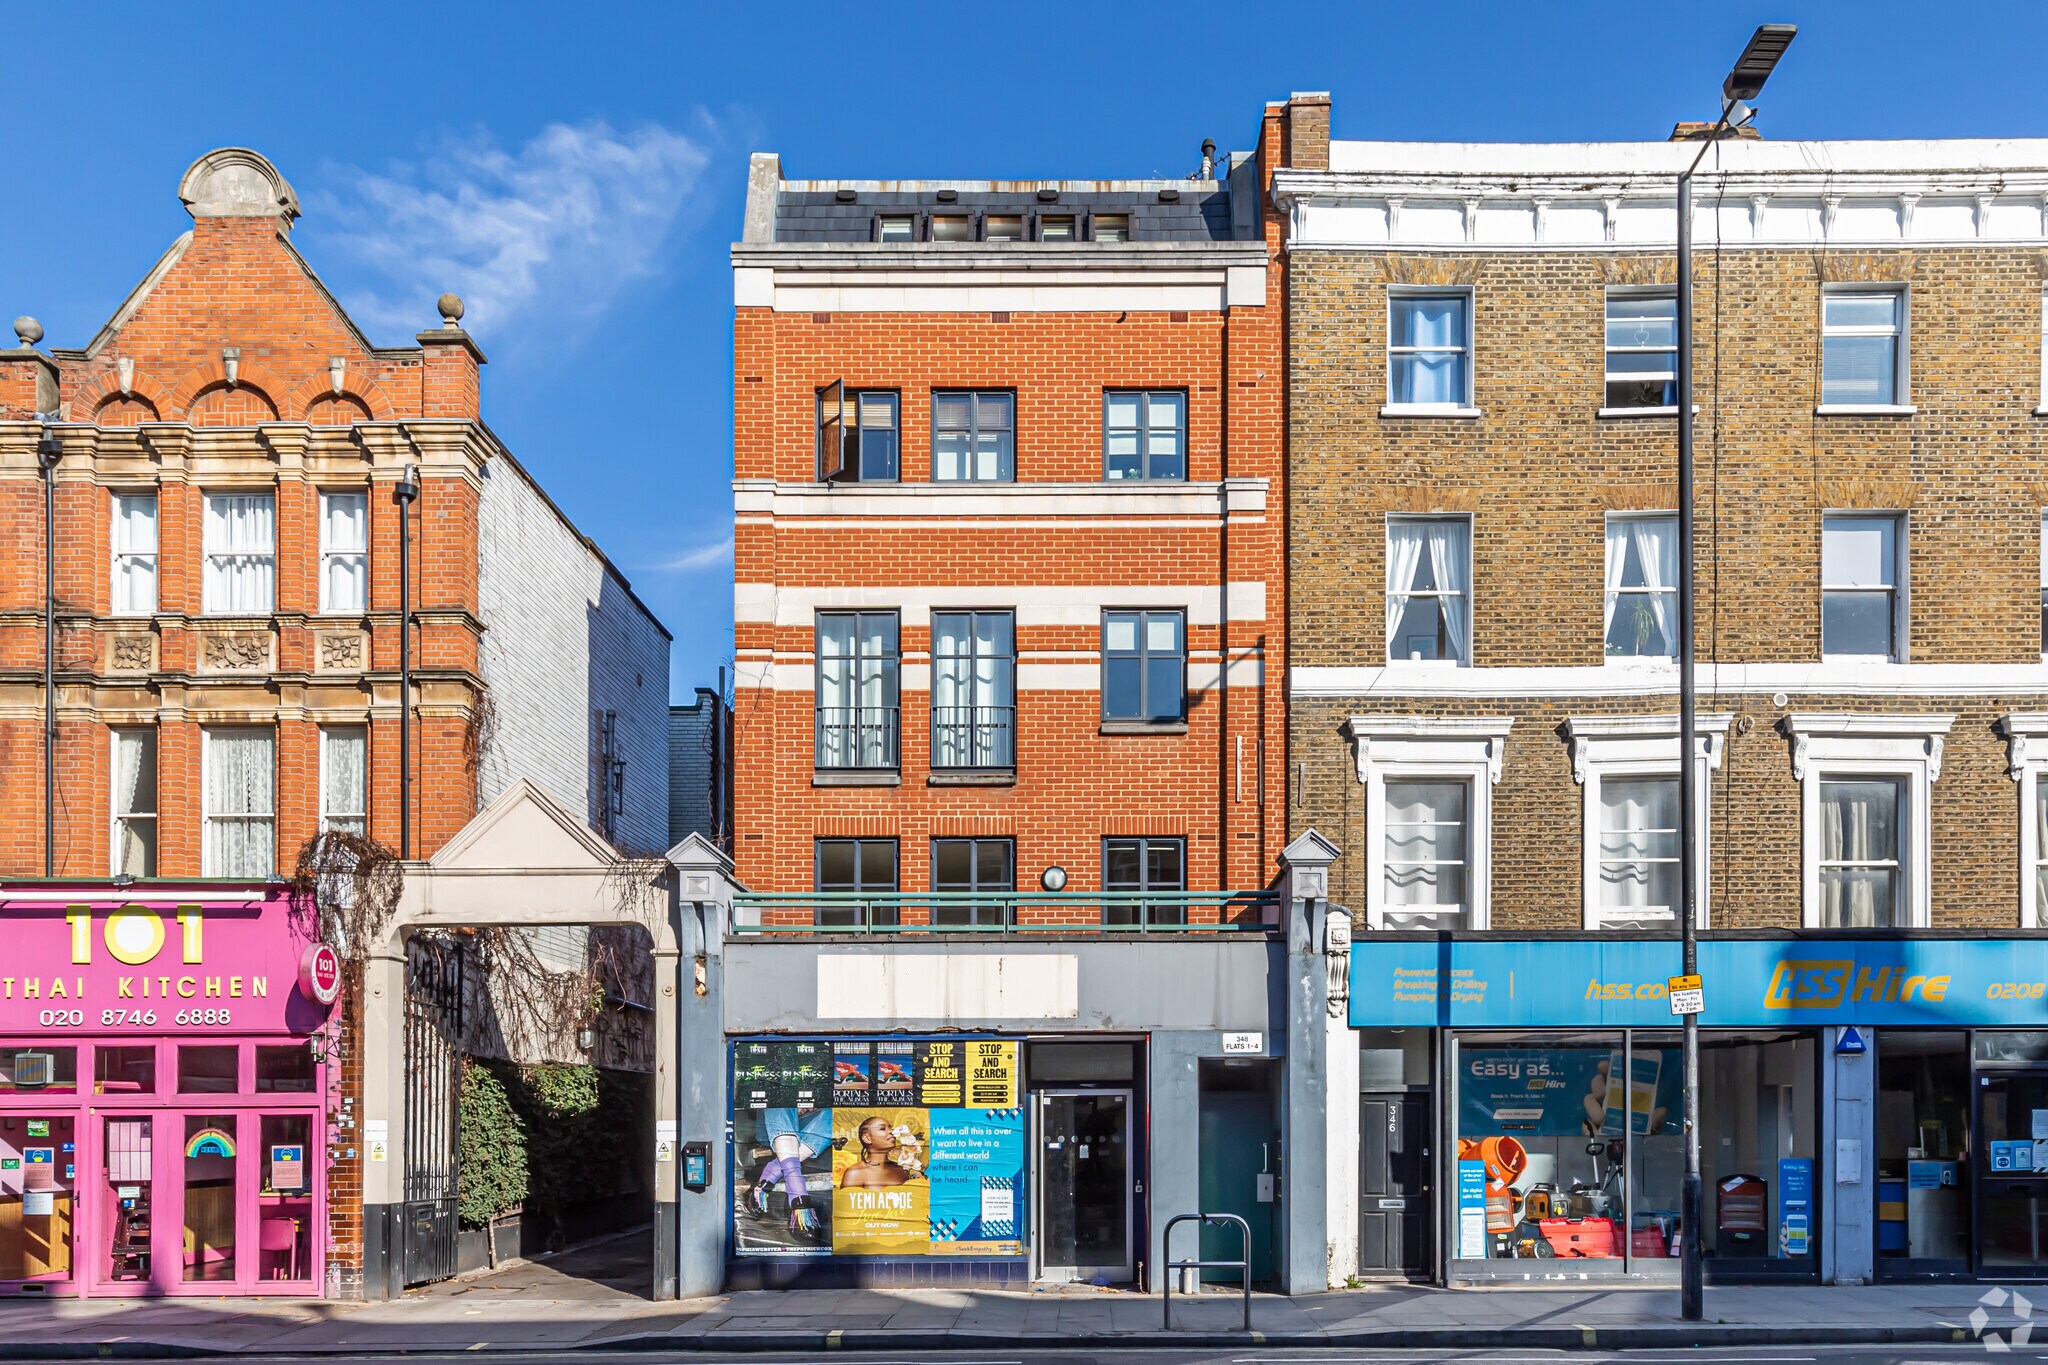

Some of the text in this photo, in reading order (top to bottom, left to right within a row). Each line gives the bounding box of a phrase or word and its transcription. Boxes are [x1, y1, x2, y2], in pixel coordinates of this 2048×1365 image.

[66, 904, 203, 965] 101
[318, 958, 333, 972] 101
[1393, 967, 1438, 977] Powered
[3, 976, 267, 999] THAI KITCHEN
[1393, 979, 1438, 991] Breaking
[1452, 979, 1488, 991] Drilling
[1774, 966, 1951, 1002] HSS Hire
[1986, 982, 2046, 1000] 0208
[1393, 991, 1437, 1003] Pumping
[1450, 991, 1485, 1003] Drying
[40, 1008, 232, 1027] 020 8746 6888
[929, 1043, 954, 1054] STOP
[978, 1043, 1002, 1054] STOP
[932, 1056, 951, 1068] AND
[981, 1057, 999, 1068] AND
[924, 1067, 959, 1079] SEARCH
[973, 1068, 1007, 1079] SEARCH
[1471, 1060, 1564, 1080] Easy as...
[1545, 1079, 1566, 1089] Hire
[833, 1089, 870, 1097] PORTALS
[877, 1089, 914, 1097] PORTALS
[932, 1126, 957, 1135] When
[958, 1126, 969, 1135] all
[970, 1126, 984, 1135] this
[985, 1127, 992, 1135] is
[931, 1139, 935, 1147] I
[968, 1138, 983, 1147] live
[984, 1139, 992, 1147] in
[931, 1150, 990, 1160] different world
[931, 1163, 957, 1171] where
[931, 1175, 969, 1183] be heard.
[849, 1192, 876, 1209] YEMI
[955, 1245, 993, 1253] #SeekEmpathy
